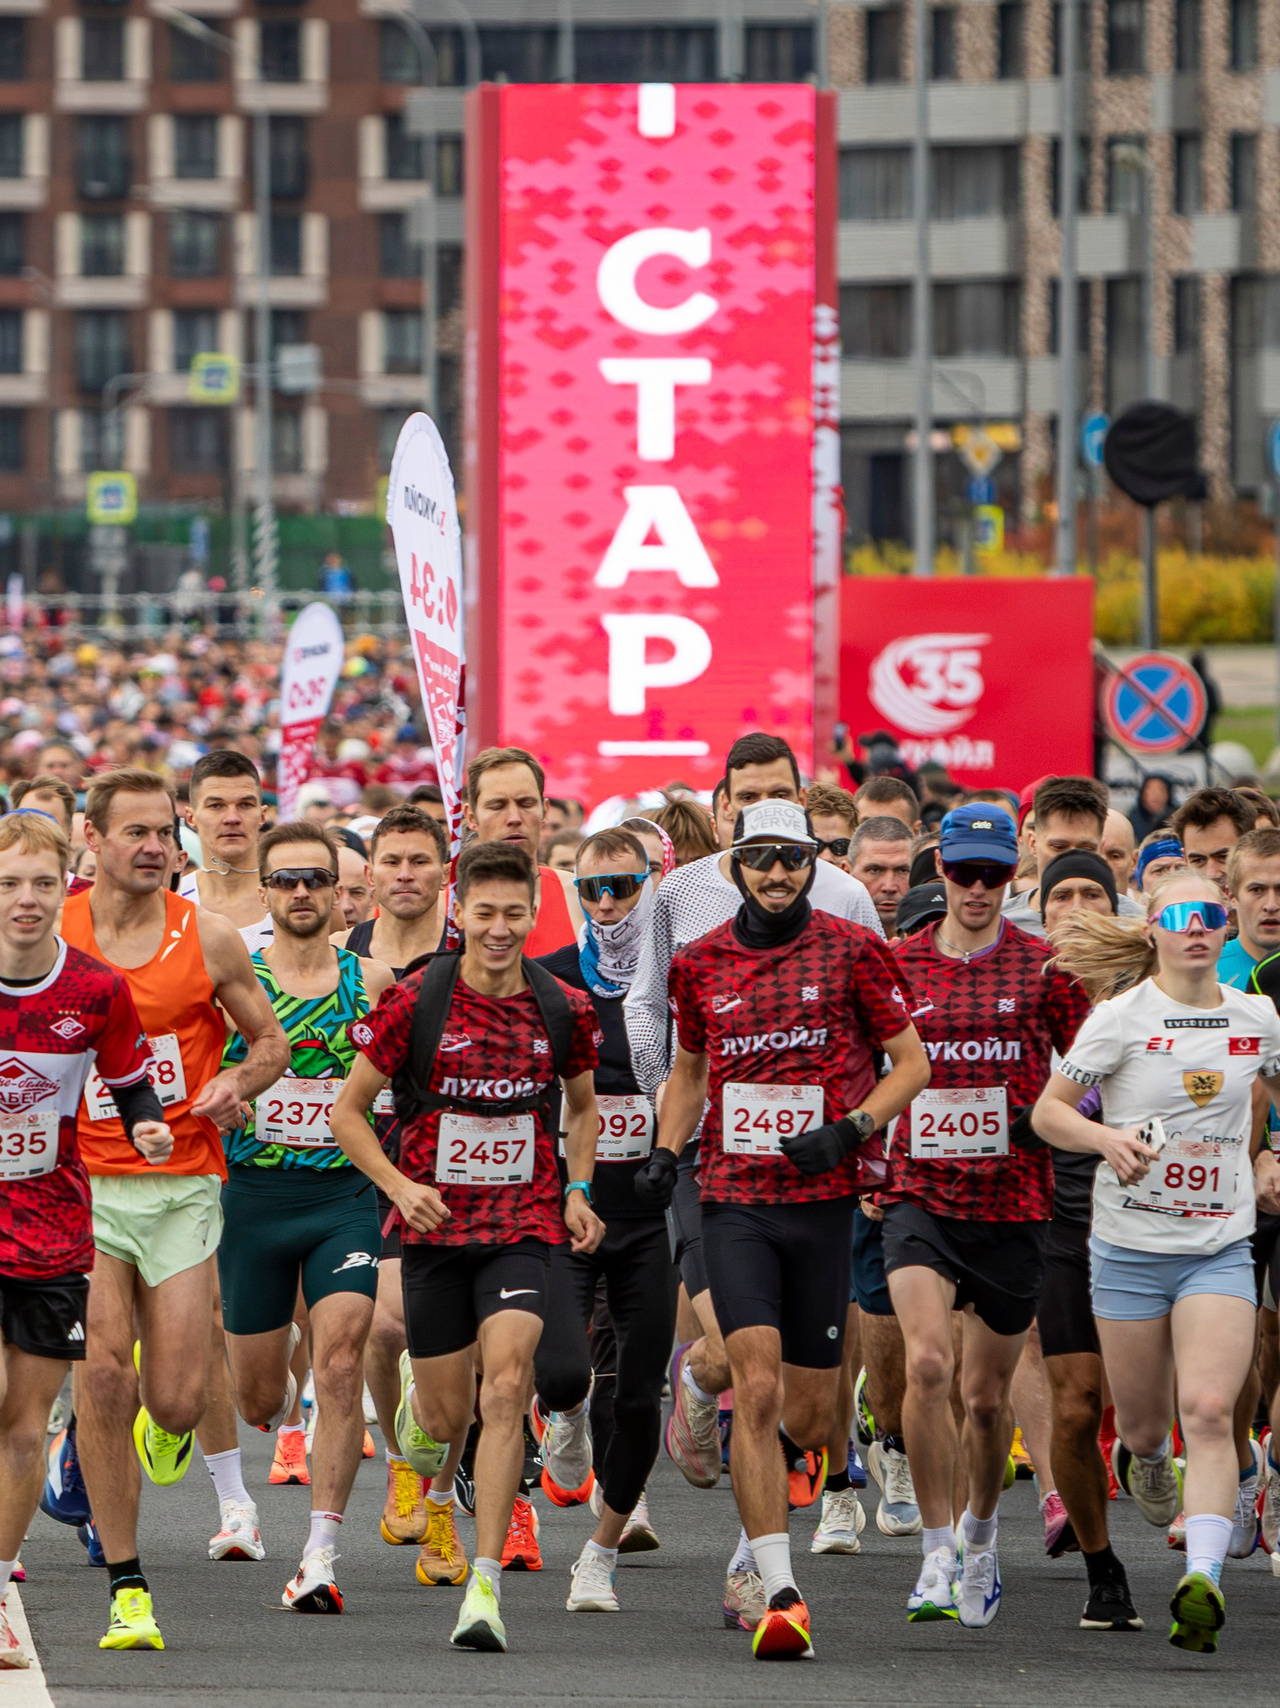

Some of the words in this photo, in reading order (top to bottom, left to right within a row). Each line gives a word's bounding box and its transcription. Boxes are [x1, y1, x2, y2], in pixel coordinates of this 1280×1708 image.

[911, 649, 985, 708] 35
[750, 817, 802, 832] VERVE
[754, 807, 797, 821] AERO
[720, 1025, 828, 1056] ЛУКОЙЛ
[733, 1108, 815, 1135] 2487
[919, 1110, 1001, 1137] 2405
[449, 1139, 527, 1165] 2457
[1164, 1162, 1220, 1192] 891
